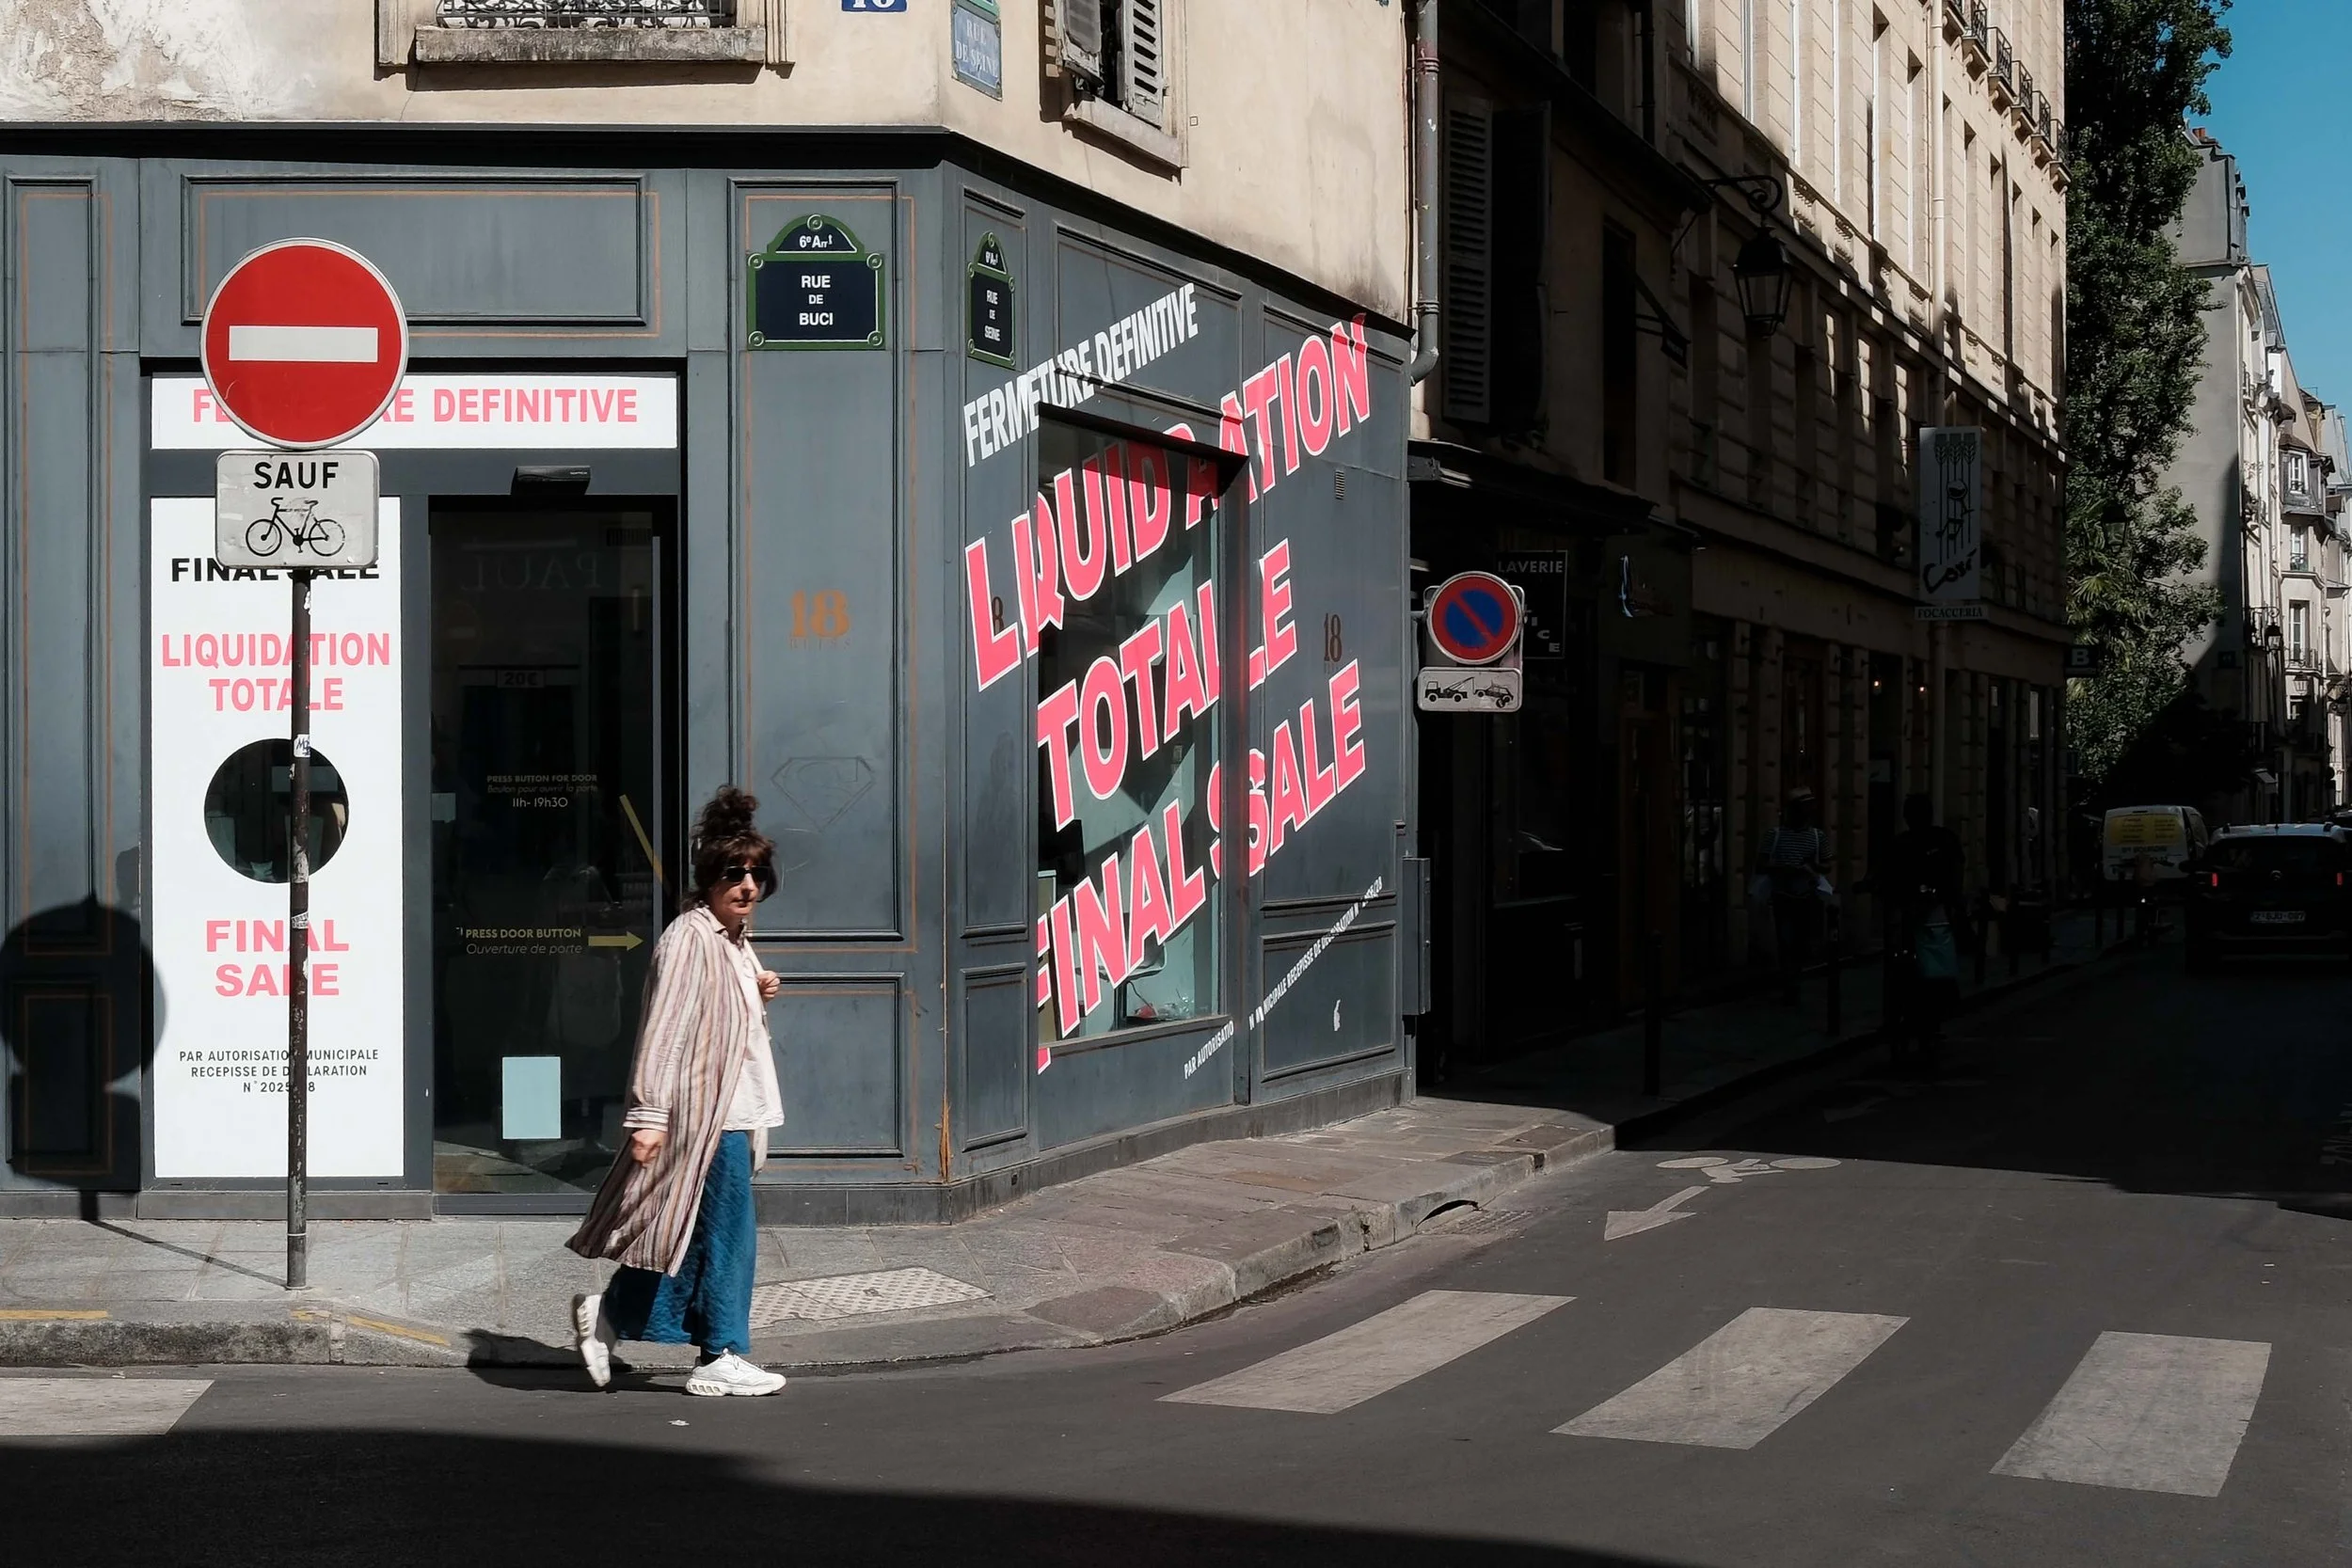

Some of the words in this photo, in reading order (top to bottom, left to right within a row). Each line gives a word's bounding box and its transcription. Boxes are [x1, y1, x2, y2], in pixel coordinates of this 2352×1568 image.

[966, 19, 987, 45] RUE
[956, 40, 969, 62] DE
[971, 48, 998, 78] SEINE
[801, 275, 831, 289] RUE
[808, 294, 824, 305] DE
[986, 290, 998, 305] RUE
[799, 312, 834, 325] BUCI
[989, 309, 995, 320] DE
[963, 340, 1095, 467] FERMETURE
[1094, 282, 1199, 388] DEFINITIVE
[434, 388, 638, 422] DEFINITIVE
[253, 462, 339, 489] SAUF
[964, 313, 1372, 691] LIQUIDATION
[1497, 560, 1564, 573] LAVERIE
[790, 588, 850, 638] 18
[1918, 607, 1982, 618] FOCACCERIA
[1324, 612, 1343, 662] 18
[2071, 649, 2090, 665] B
[1037, 537, 1298, 832] TOTALE
[1207, 658, 1366, 879] SALE
[571, 774, 597, 783] DOOR
[534, 797, 568, 807] 19h30
[466, 928, 498, 939] PRESS
[501, 928, 533, 939] DOOR
[536, 928, 581, 938] BUTTON
[466, 943, 528, 955] Ouverture
[531, 943, 546, 954] de
[549, 944, 583, 956] porte
[180, 1051, 202, 1062] PAR
[208, 1050, 290, 1061] AUTORISATIO
[191, 1066, 257, 1077] RECEPISSE
[262, 1066, 278, 1077] DE
[282, 1065, 367, 1076] DLARATION
[1184, 1056, 1198, 1081] PAR
